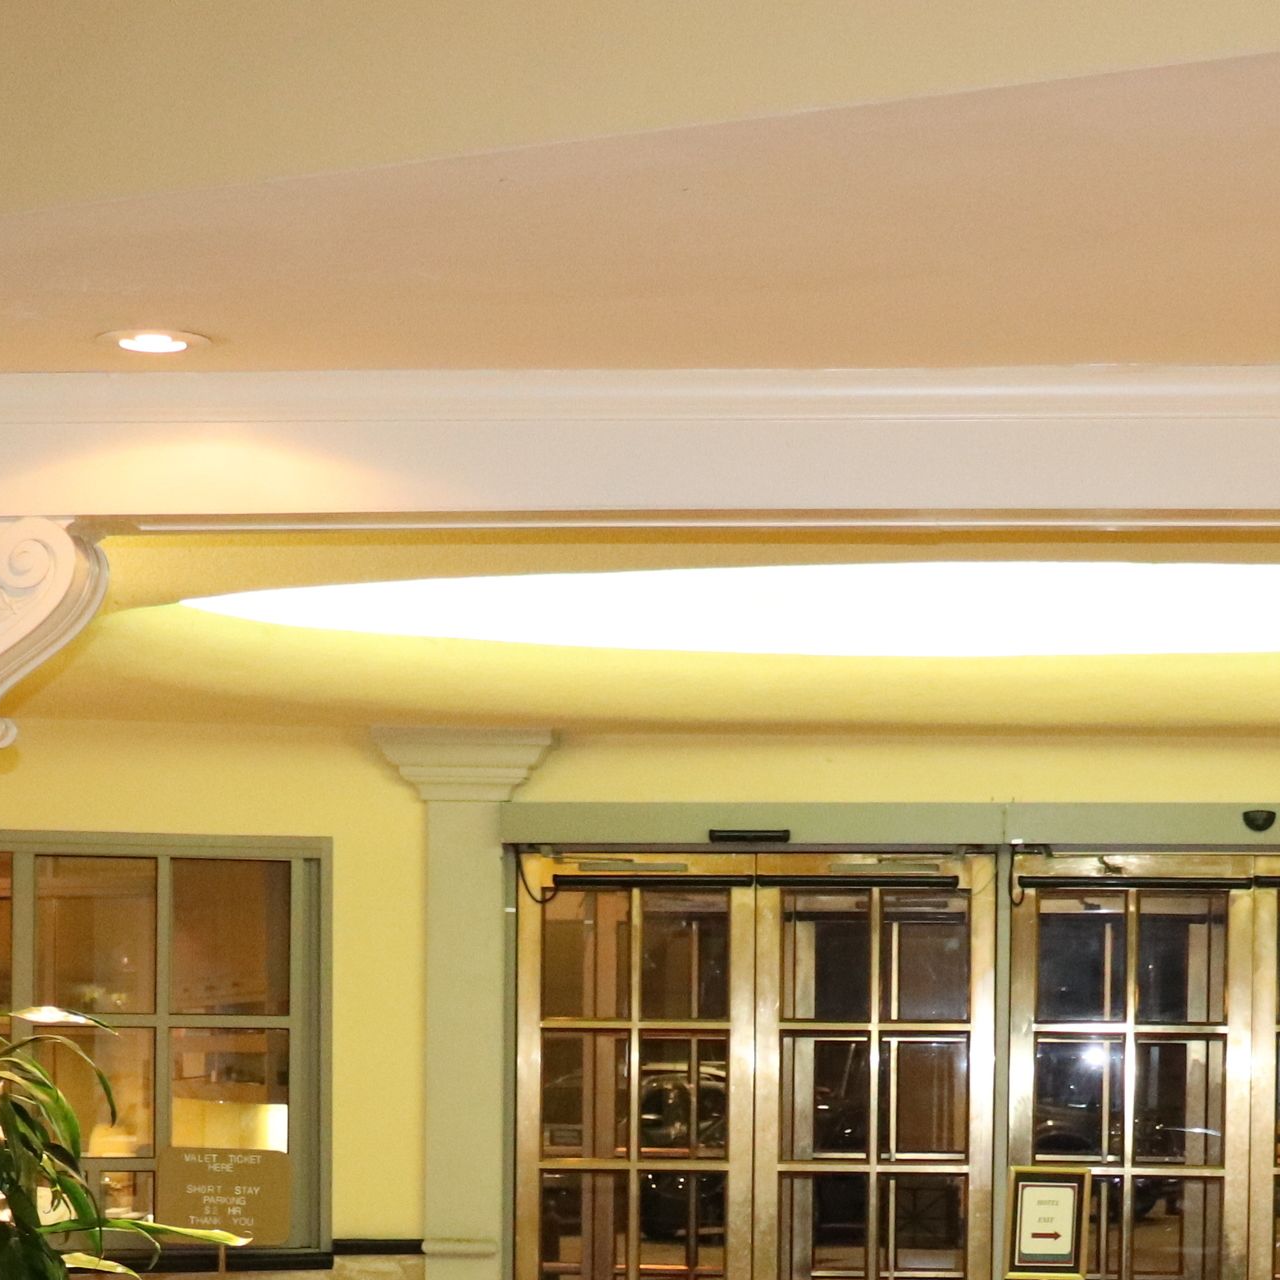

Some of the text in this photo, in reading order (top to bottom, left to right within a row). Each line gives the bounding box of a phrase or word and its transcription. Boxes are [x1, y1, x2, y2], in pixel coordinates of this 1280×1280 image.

[183, 1153, 262, 1164] VALET TICKET
[207, 1162, 234, 1172] HERE
[186, 1184, 261, 1195] SHORT STAY
[202, 1195, 246, 1205] PARKING
[227, 1206, 242, 1216] HR
[188, 1215, 254, 1226] THANK YOU
